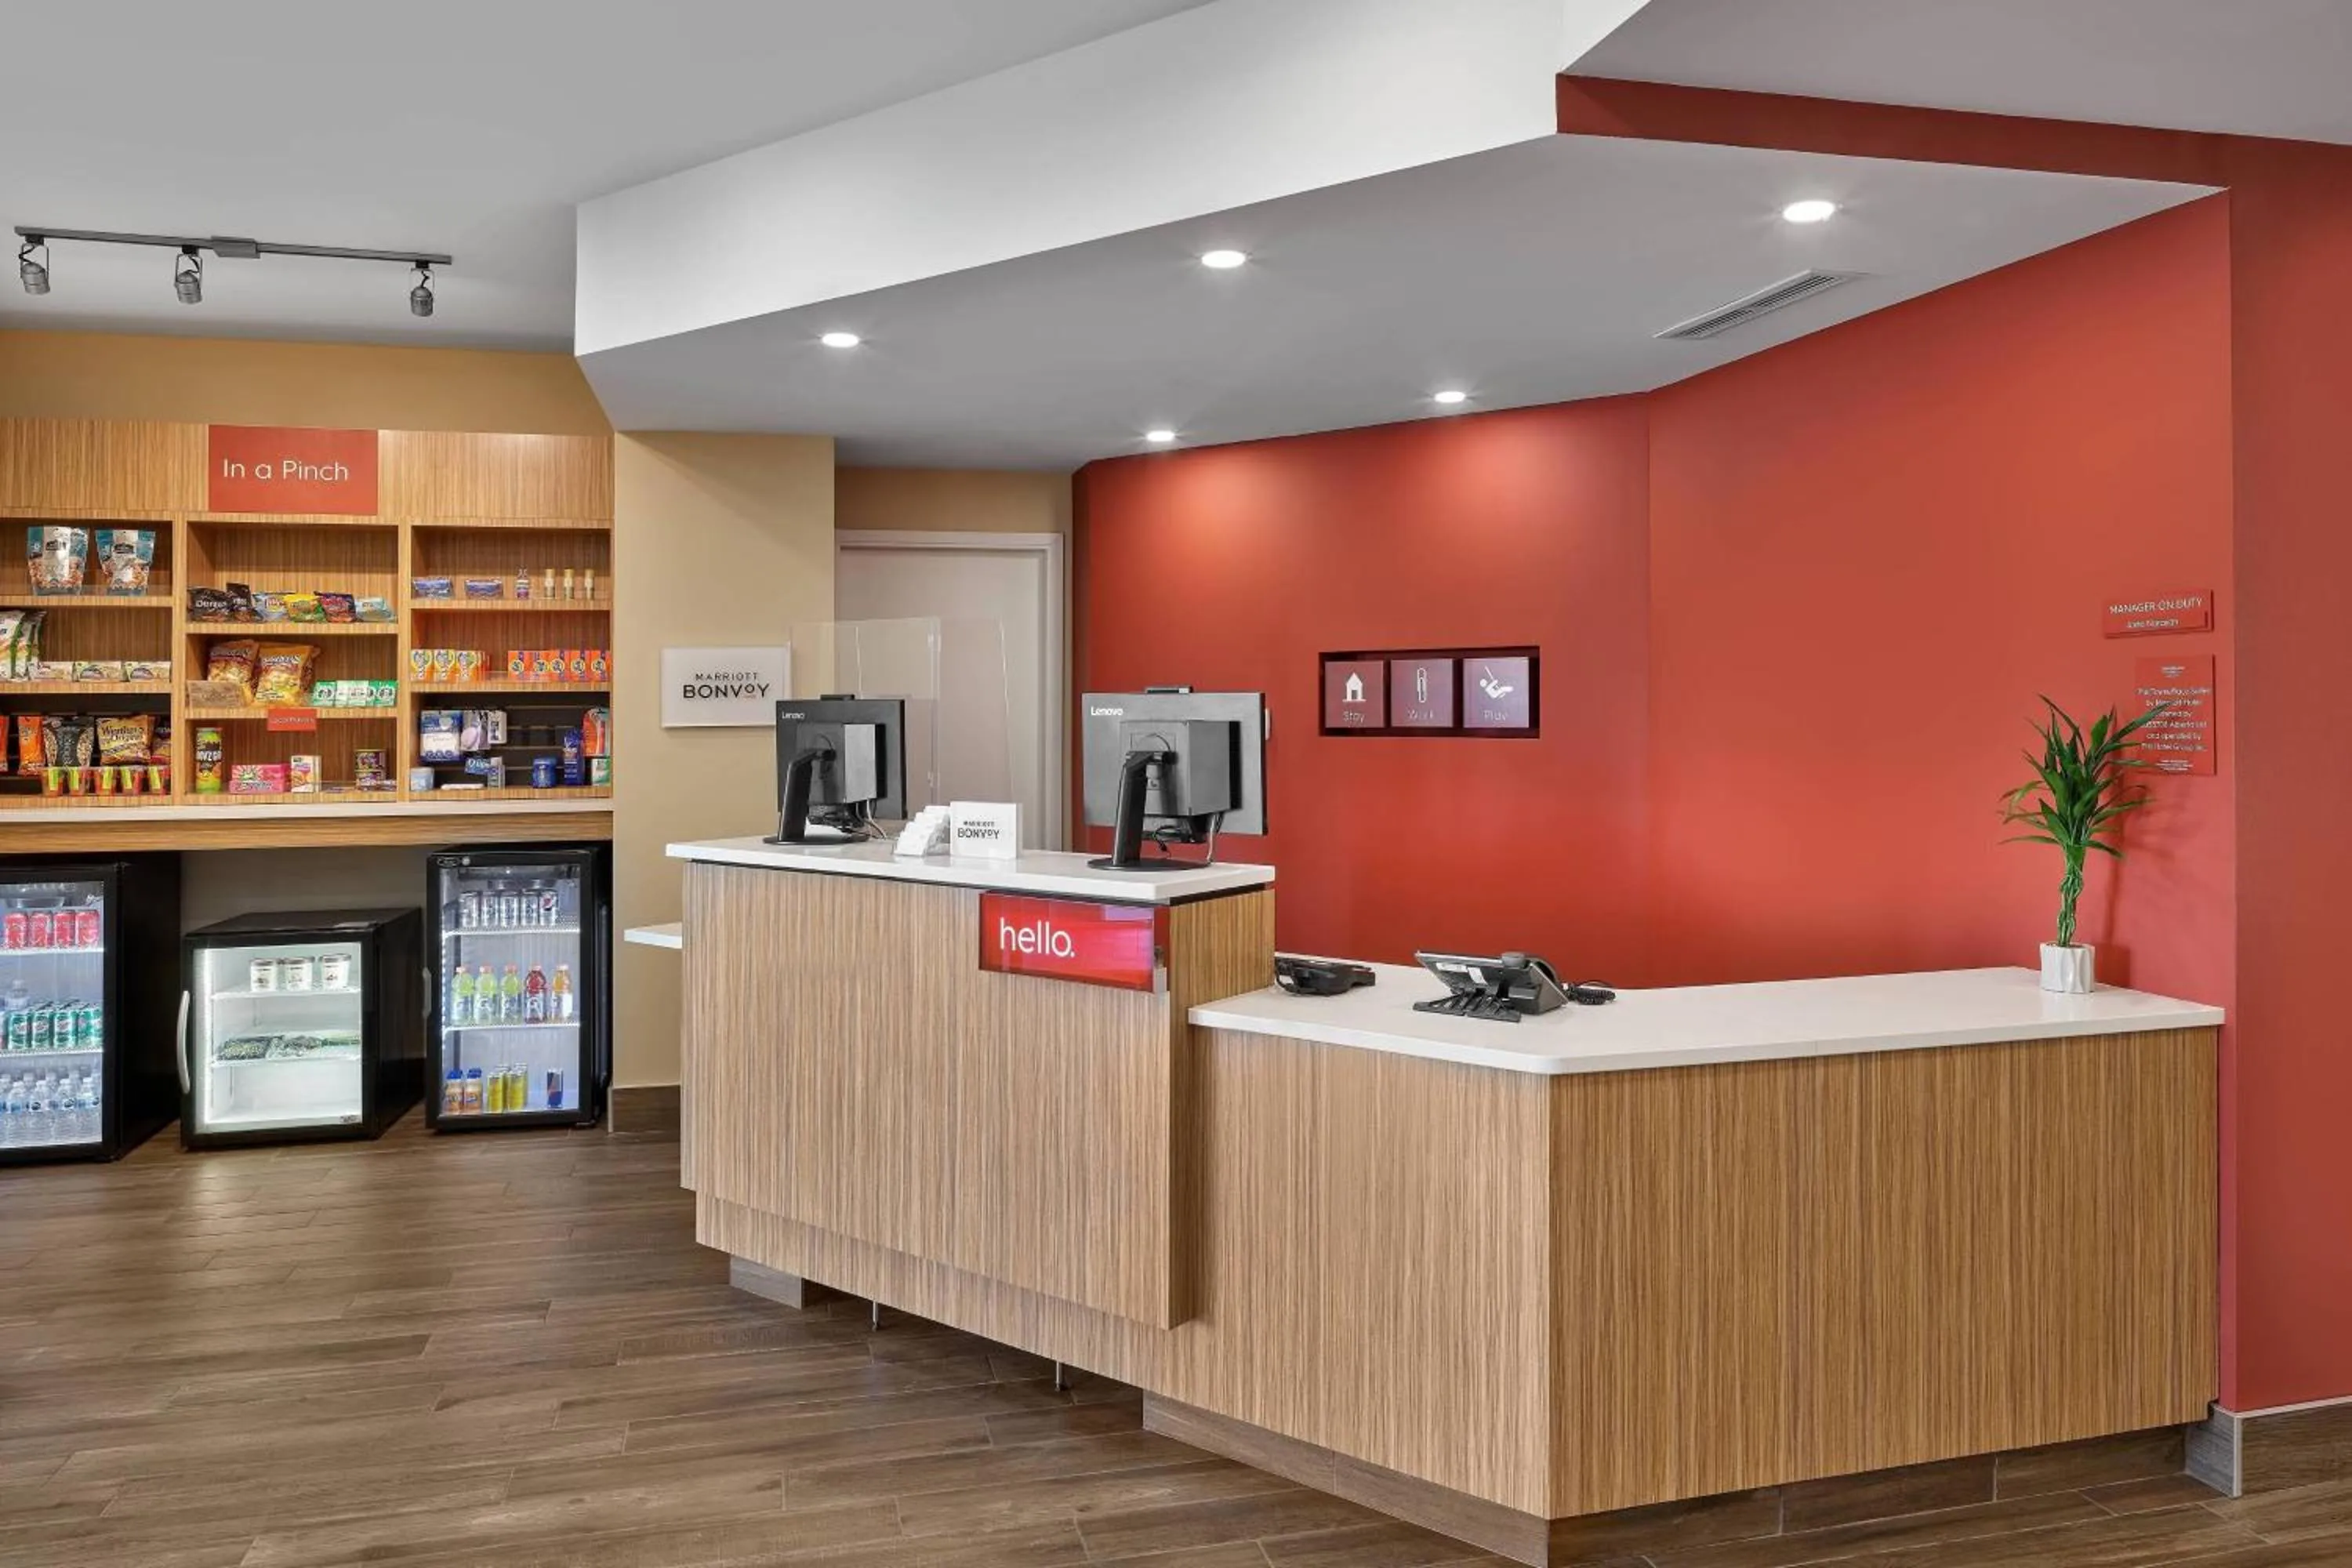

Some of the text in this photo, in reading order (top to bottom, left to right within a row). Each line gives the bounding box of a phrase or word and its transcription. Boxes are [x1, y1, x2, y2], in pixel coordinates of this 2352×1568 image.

[223, 458, 349, 481] In a Pinch
[2109, 596, 2203, 614] MANAGER ON DUTY
[695, 672, 758, 681] MARRIOTT
[683, 683, 770, 699] BONVOY
[1091, 706, 1123, 716] Lenovo
[1342, 710, 1365, 722] Stay
[1483, 709, 1508, 721] Play
[1000, 916, 1076, 958] hello.
